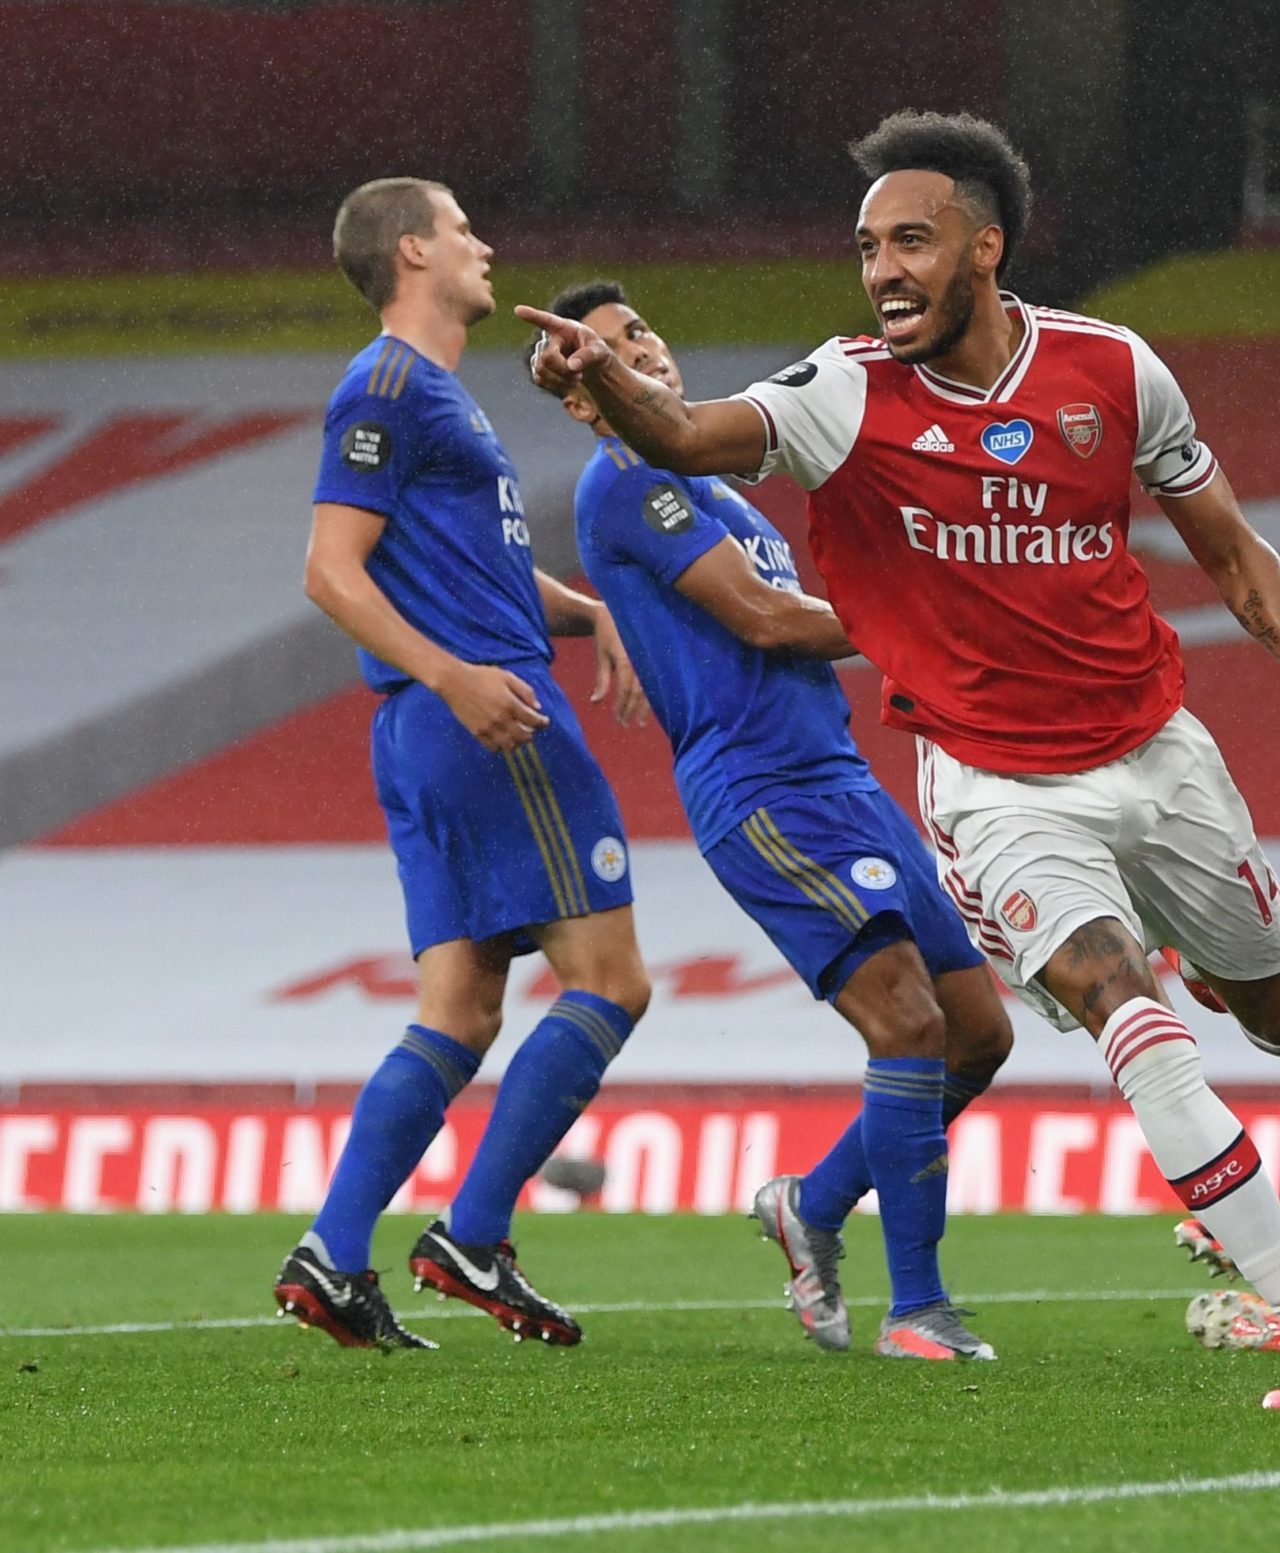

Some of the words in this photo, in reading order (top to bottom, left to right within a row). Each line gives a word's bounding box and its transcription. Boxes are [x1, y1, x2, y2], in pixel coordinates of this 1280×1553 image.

[911, 440, 955, 453] adidas
[992, 432, 1023, 449] NHS
[981, 475, 1048, 517] Fly
[899, 505, 1114, 565] Emirates
